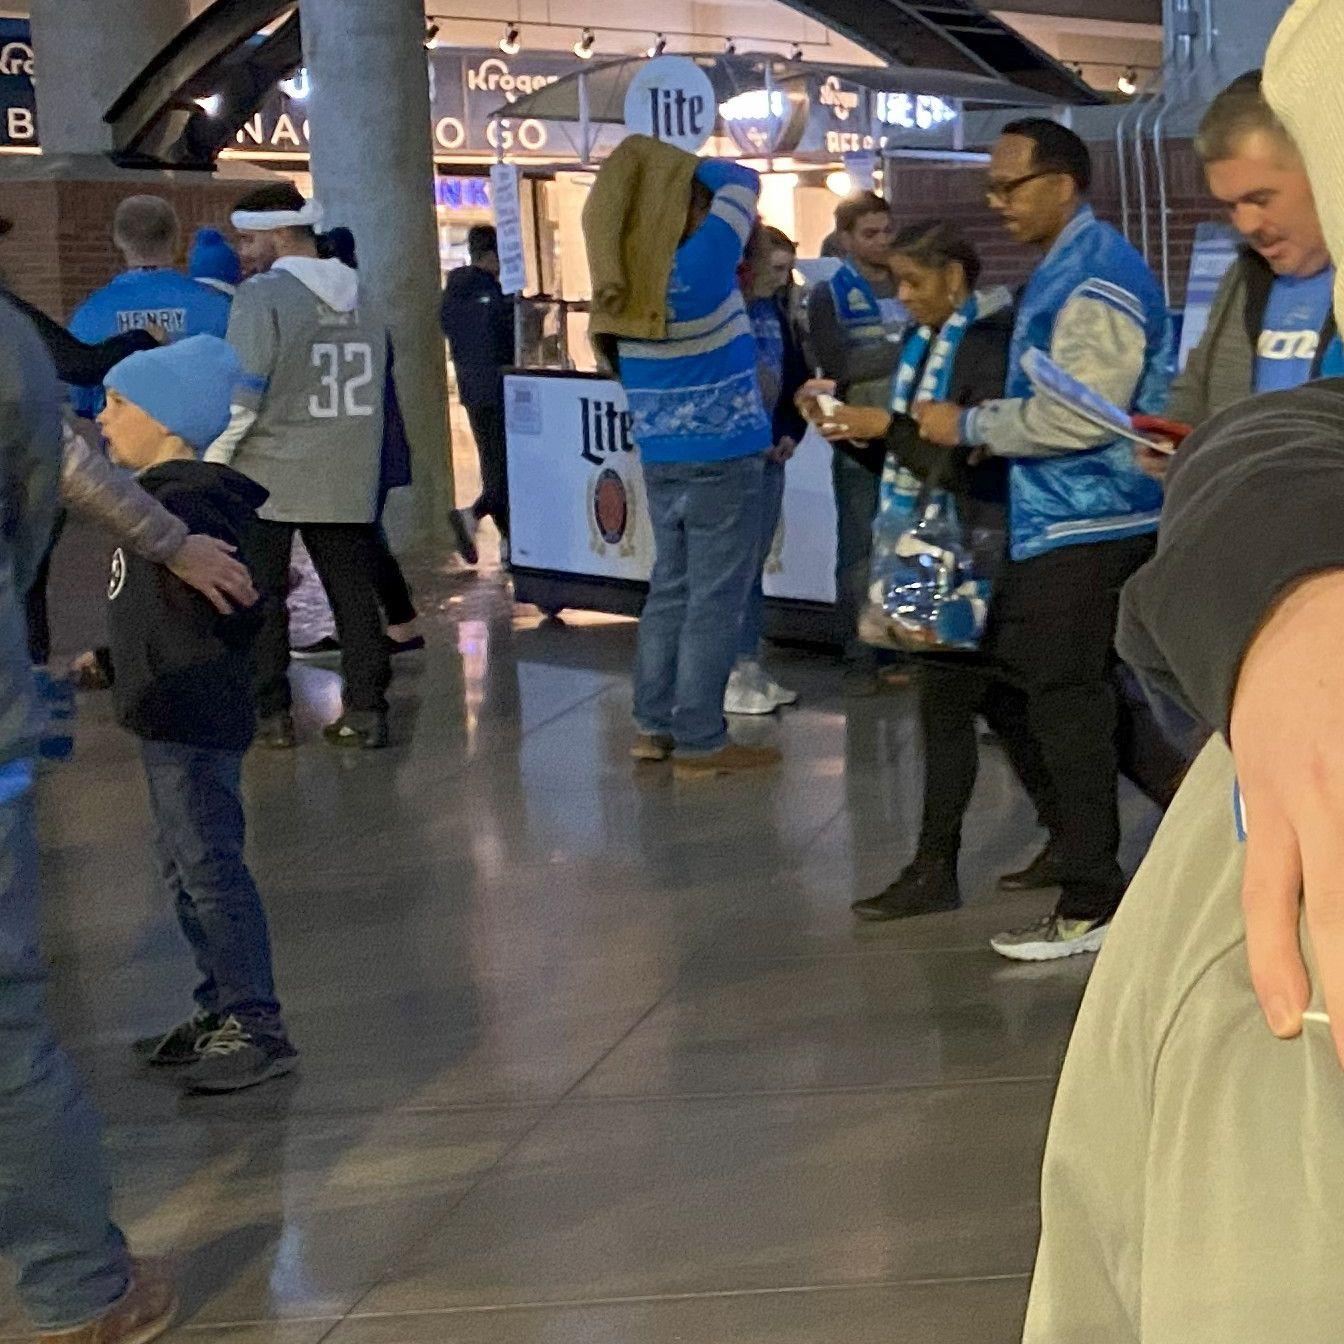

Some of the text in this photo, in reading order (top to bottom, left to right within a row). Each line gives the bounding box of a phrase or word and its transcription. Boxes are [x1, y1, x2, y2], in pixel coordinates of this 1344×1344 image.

[486, 118, 548, 151] GO
[116, 308, 188, 333] HENRY
[307, 342, 374, 418] 32
